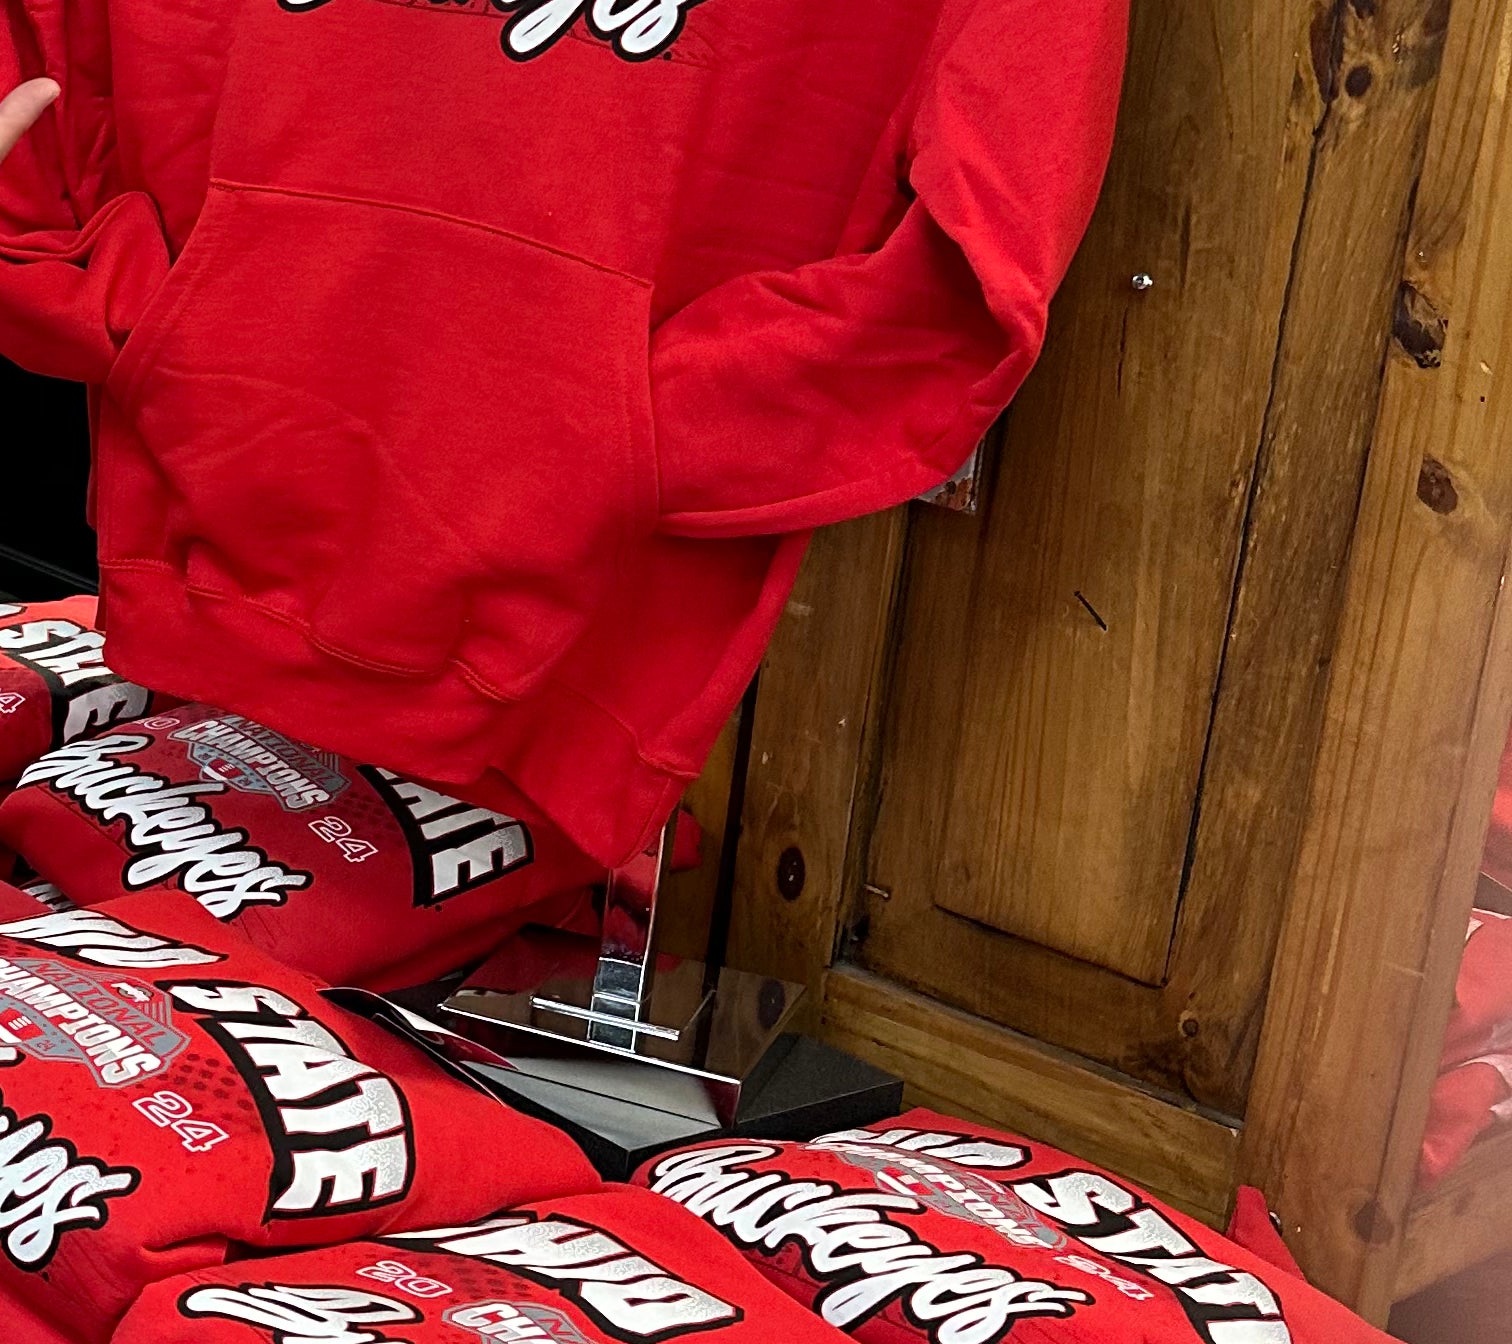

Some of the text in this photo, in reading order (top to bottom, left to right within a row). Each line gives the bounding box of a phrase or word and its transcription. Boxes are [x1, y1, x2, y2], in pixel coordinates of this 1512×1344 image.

[16, 734, 313, 919] Buckeyes
[170, 716, 333, 811] CHAMPIONS
[306, 813, 380, 864] 24
[22, 958, 168, 1050] NATIONAL
[130, 1088, 231, 1154] 24
[164, 978, 416, 1219] STATE
